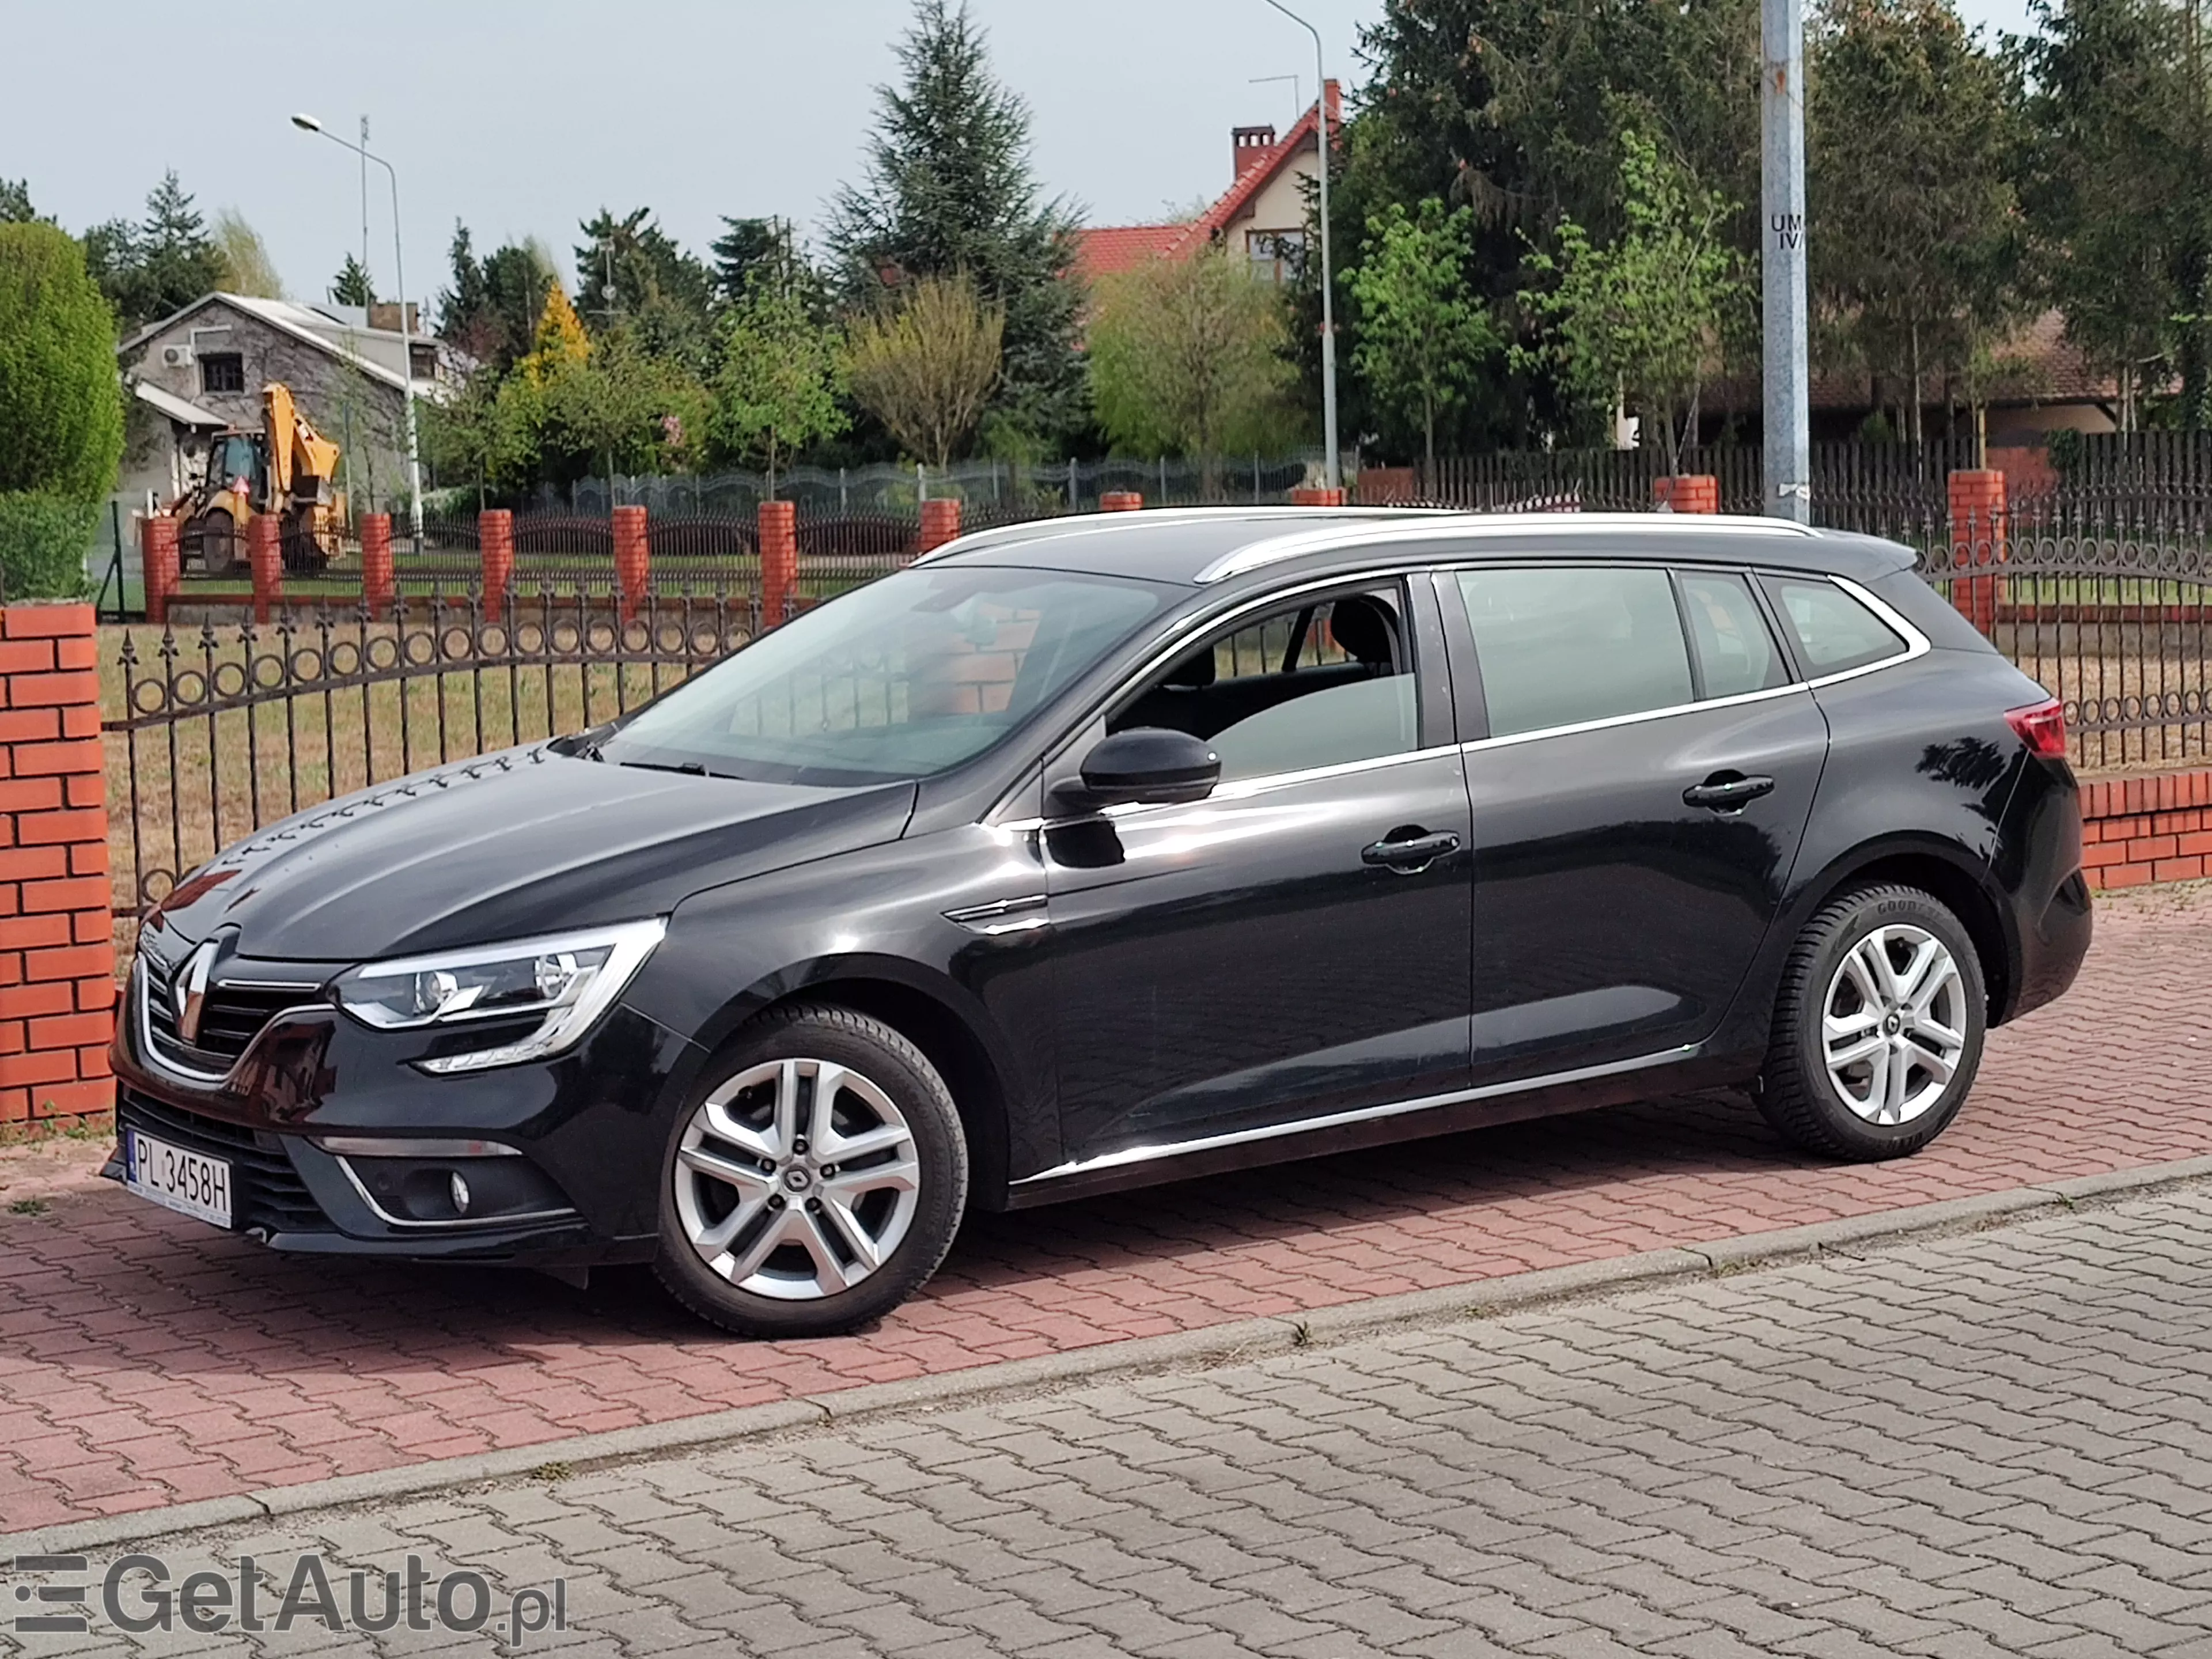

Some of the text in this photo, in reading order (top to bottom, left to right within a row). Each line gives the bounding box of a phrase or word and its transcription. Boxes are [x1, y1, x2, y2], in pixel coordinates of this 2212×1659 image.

[1771, 214, 1801, 232] UM
[137, 1138, 226, 1212] PL 3458H
